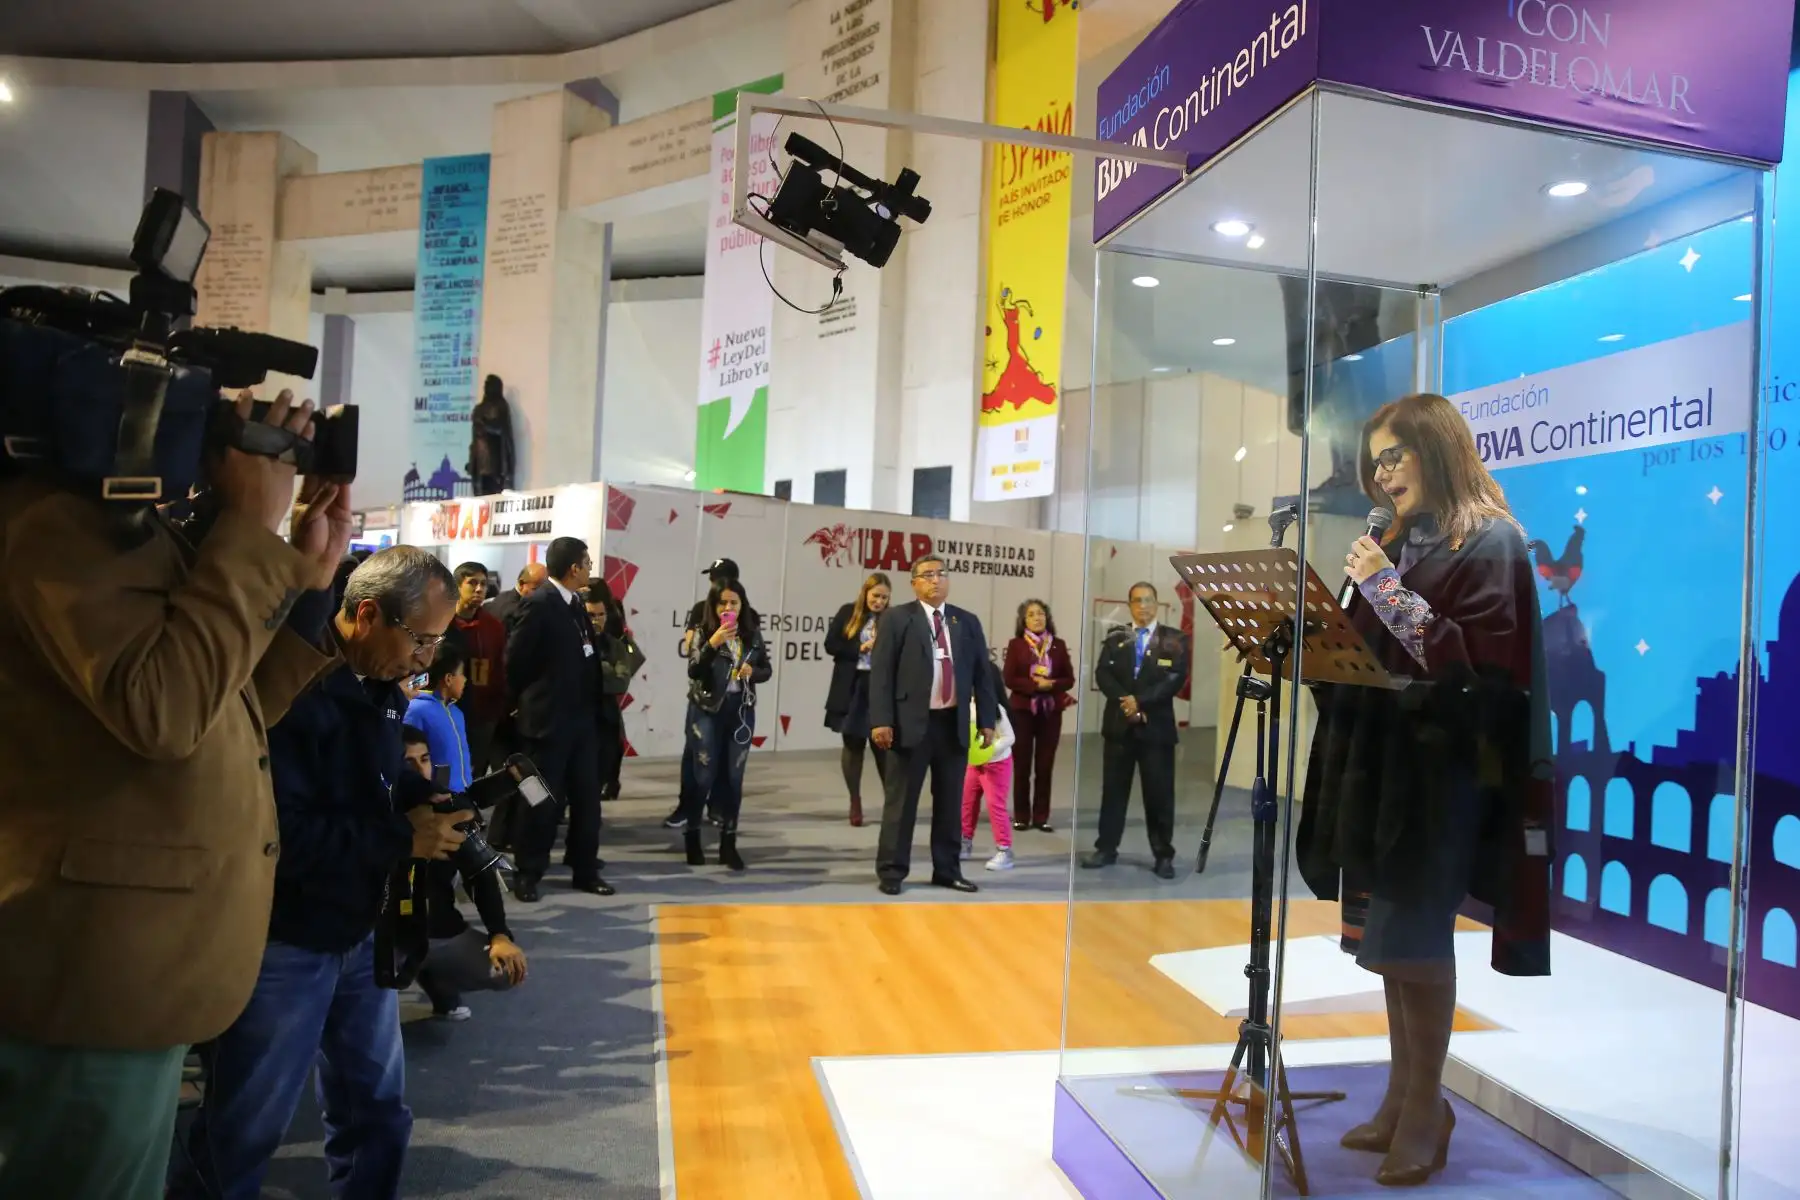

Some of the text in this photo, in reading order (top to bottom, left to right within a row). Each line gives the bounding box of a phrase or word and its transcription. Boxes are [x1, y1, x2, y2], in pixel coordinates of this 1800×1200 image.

[1517, 0, 1611, 48] CON
[1153, 0, 1306, 151] Continental
[1420, 25, 1697, 115] VALDELOMAR
[824, 72, 880, 104] EPENDENCIA
[1100, 64, 1170, 141] Fundación
[1020, 165, 1070, 198] INVITADO
[1012, 192, 1051, 219] HONOR
[720, 227, 767, 258] públic
[724, 326, 766, 348] Nueva
[1461, 384, 1549, 421] Fundación
[1476, 388, 1714, 462] BVA Continental
[1642, 444, 1681, 477] por
[1689, 439, 1725, 462] los
[447, 503, 490, 540] UAP
[859, 528, 932, 572] UAP
[937, 539, 1036, 561] UNIVERSIDAD
[945, 560, 1035, 578] LAS PERUANAS
[759, 613, 836, 633] ERSIDA
[785, 641, 823, 661] DEL
